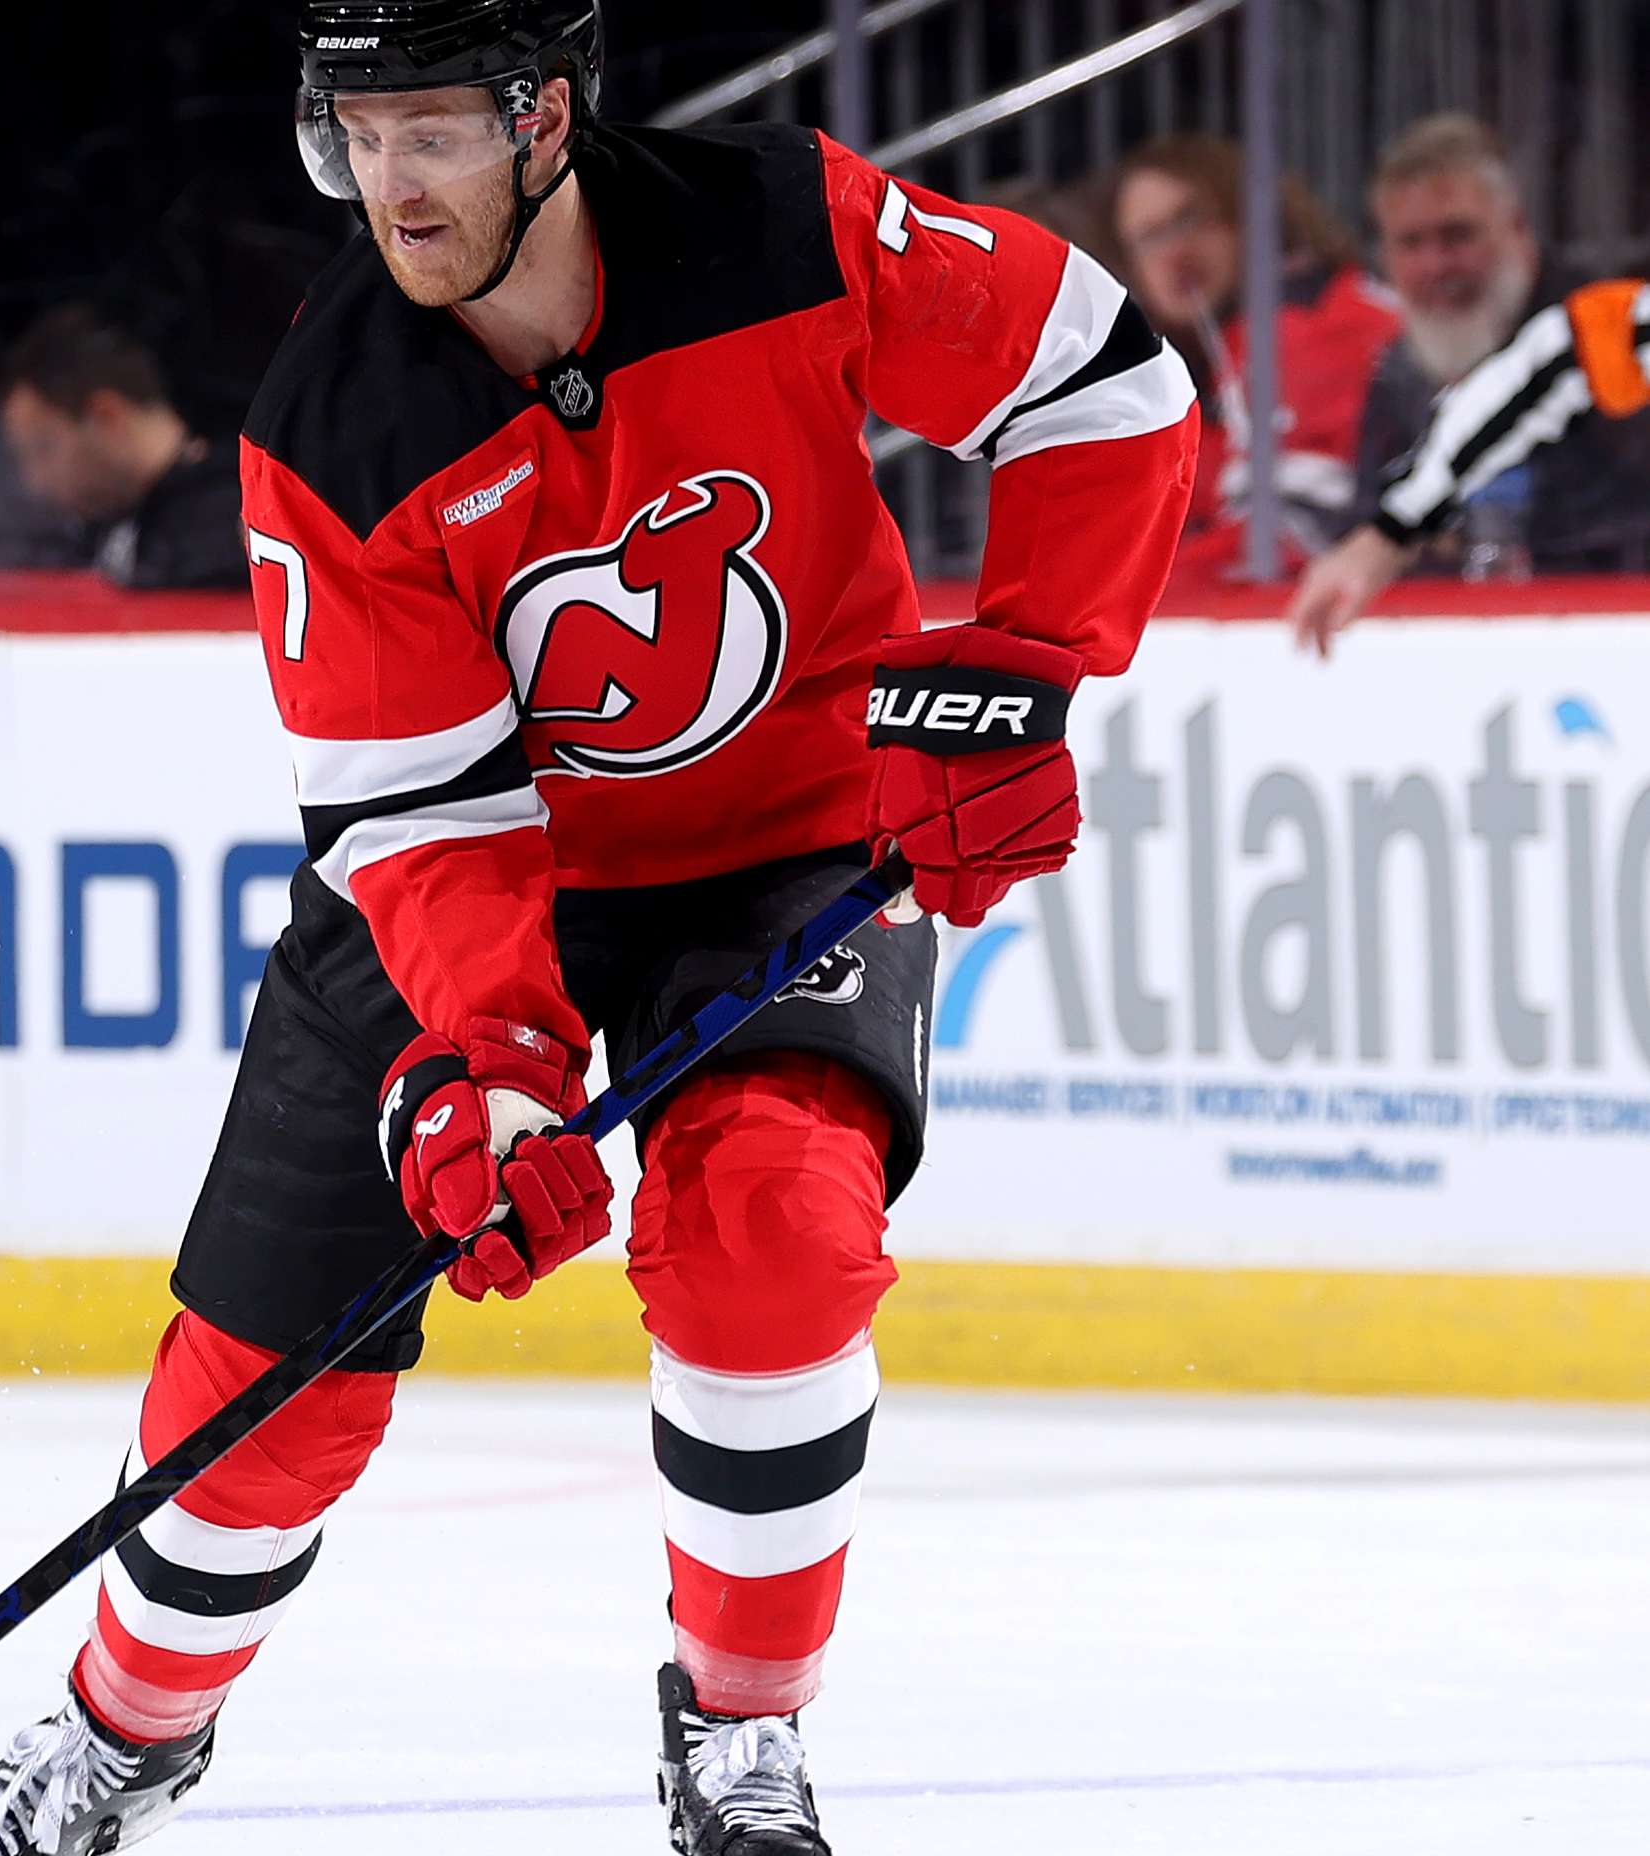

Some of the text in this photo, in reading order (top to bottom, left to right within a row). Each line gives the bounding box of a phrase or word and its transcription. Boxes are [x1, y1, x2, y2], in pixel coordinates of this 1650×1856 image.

[316, 37, 379, 49] BAUER
[876, 177, 995, 255] 7
[567, 380, 581, 411] NHL
[461, 497, 501, 524] HEALTH
[249, 526, 308, 662] 7
[866, 687, 1033, 734] AUER
